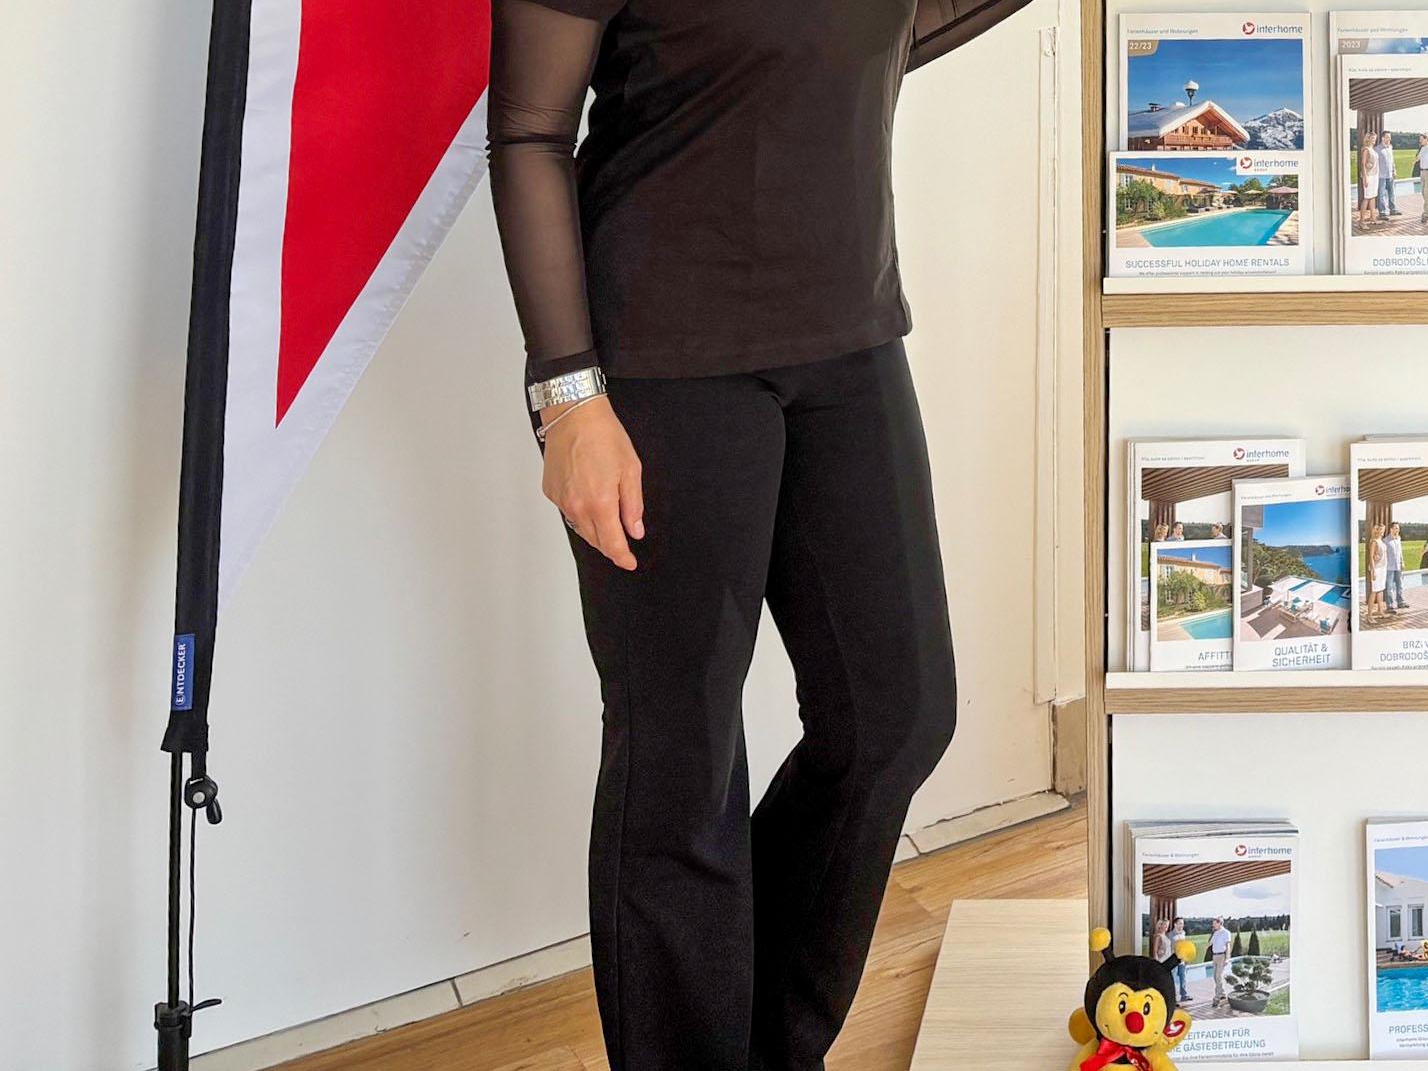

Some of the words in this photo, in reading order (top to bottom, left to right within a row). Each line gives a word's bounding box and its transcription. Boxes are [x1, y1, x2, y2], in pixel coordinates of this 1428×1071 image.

[1256, 24, 1303, 34] interhome
[1129, 41, 1152, 50] 22/23
[1341, 40, 1361, 49] 2023
[1253, 159, 1299, 168] interhome
[1395, 246, 1415, 255] BRZI
[1125, 259, 1183, 269] SUCCESSFUL
[1184, 258, 1221, 268] HOLIDAY
[1223, 258, 1249, 267] HOME
[1251, 258, 1289, 267] RENTALS
[1246, 449, 1290, 459] interhome
[1274, 642, 1318, 656] QUALITÄT
[1320, 643, 1328, 652] &
[1198, 650, 1233, 661] AFFITT
[1272, 653, 1331, 667] SICHERHEIT
[1248, 846, 1292, 855] interhome
[1232, 1027, 1250, 1038] FÜR
